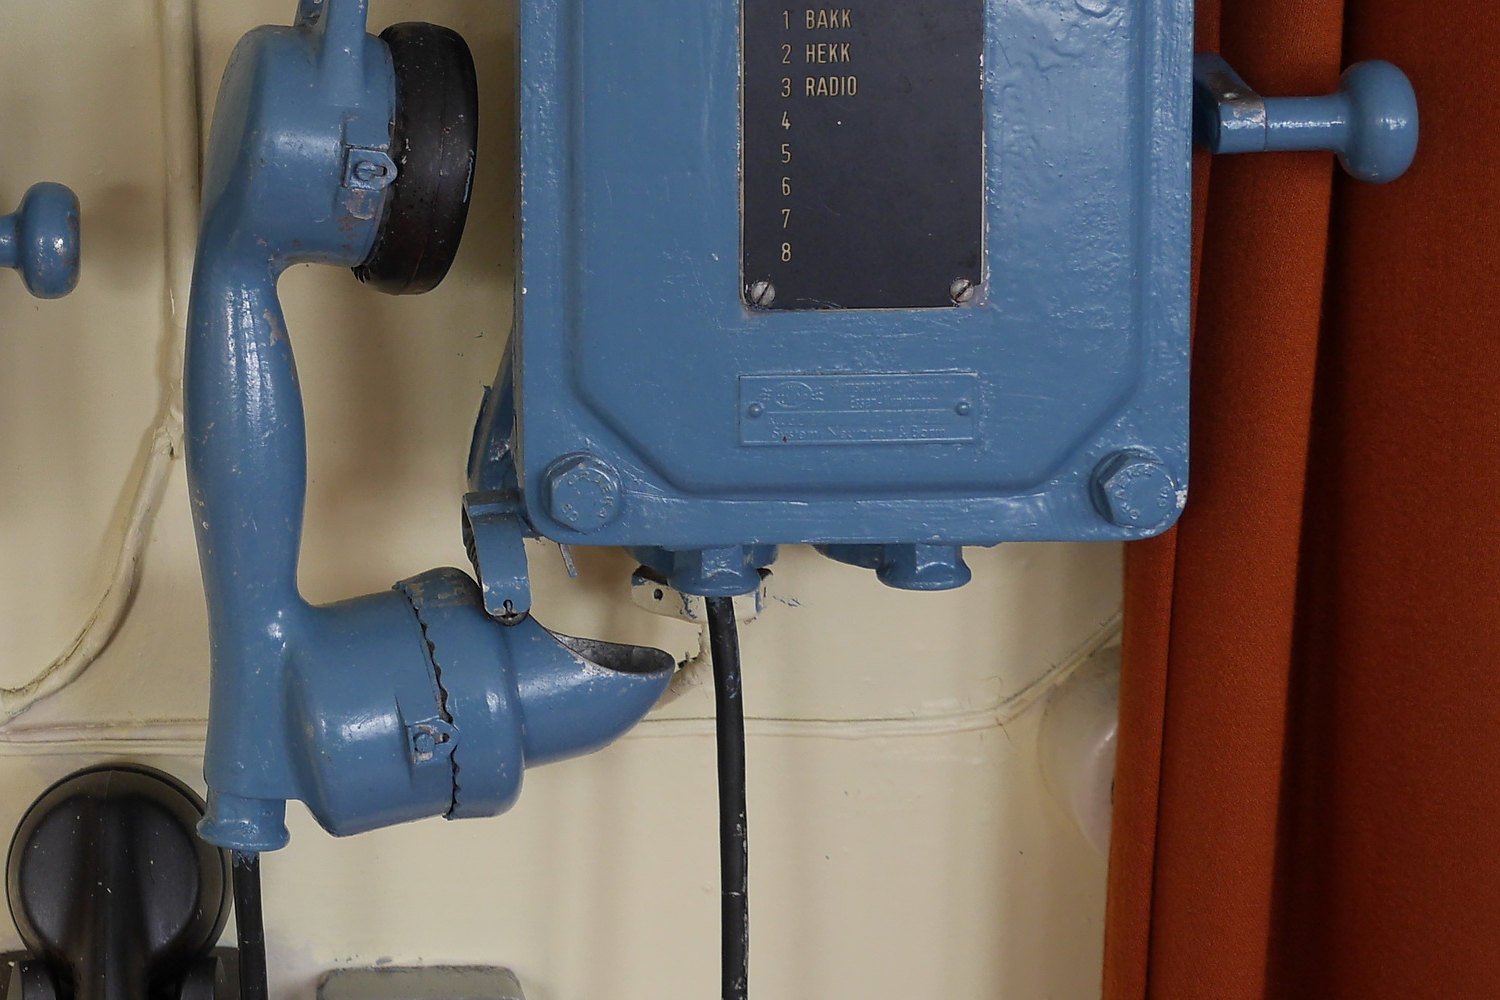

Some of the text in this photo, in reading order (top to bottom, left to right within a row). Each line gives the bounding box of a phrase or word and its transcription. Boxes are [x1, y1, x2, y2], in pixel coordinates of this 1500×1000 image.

[783, 10, 850, 29] 1 BAKK
[782, 44, 849, 63] 2 HEKK
[782, 76, 856, 97] 3 RADIO
[782, 112, 790, 129] 4
[782, 144, 790, 163] 5
[782, 177, 790, 195] 6
[782, 209, 790, 228] 7
[782, 243, 791, 261] 8
